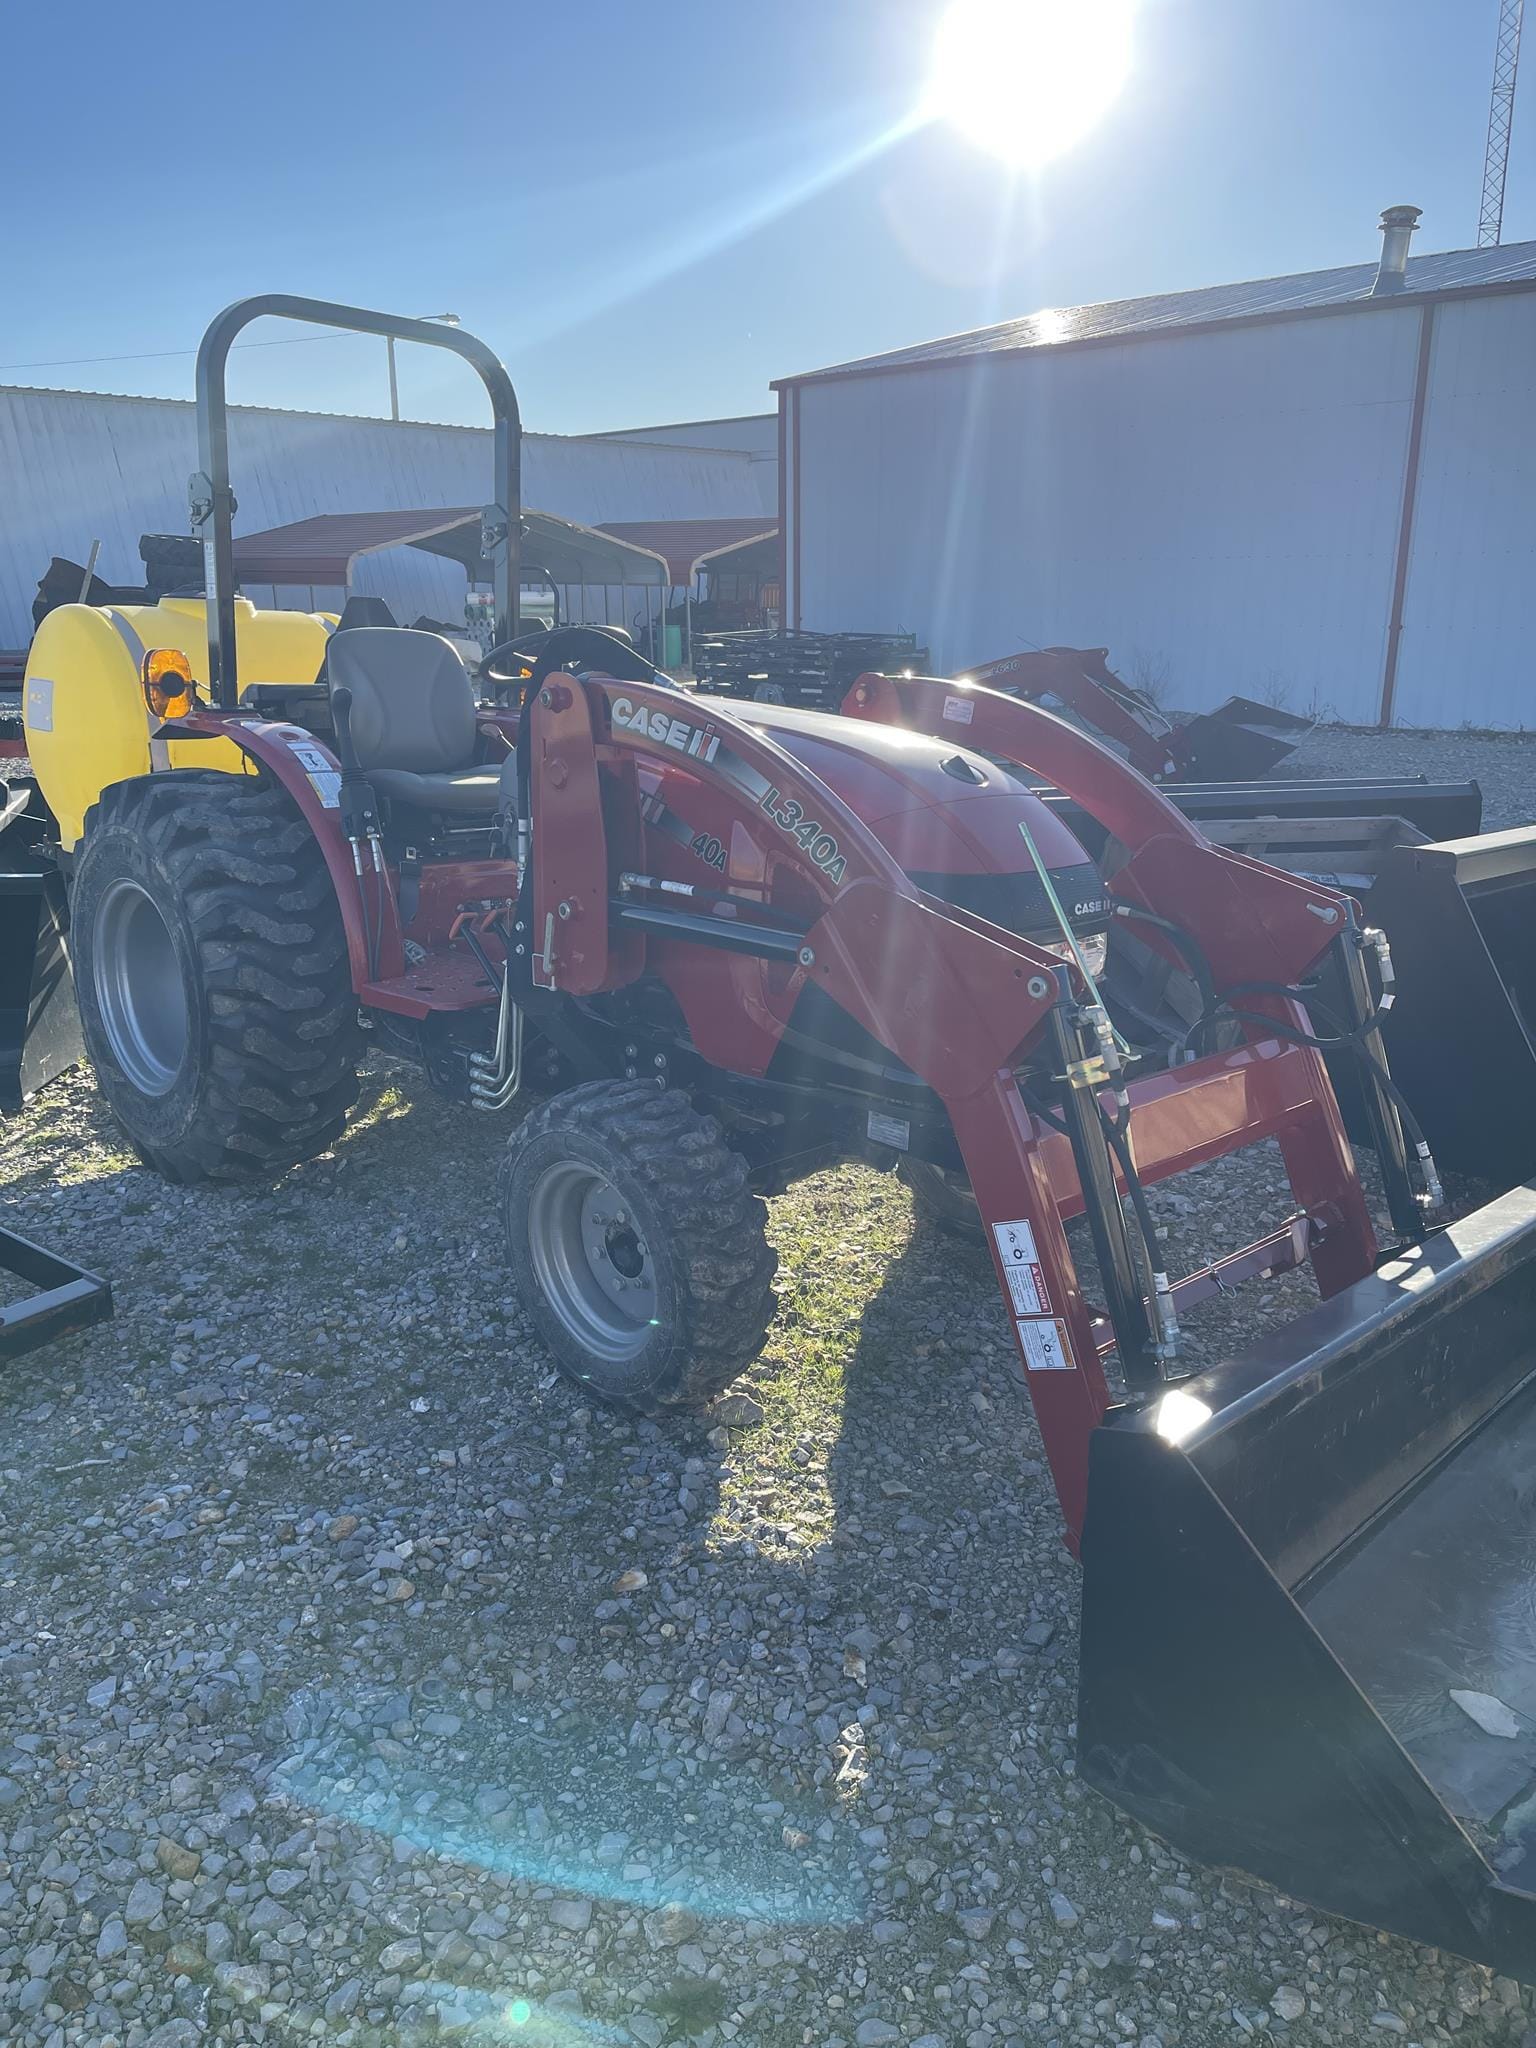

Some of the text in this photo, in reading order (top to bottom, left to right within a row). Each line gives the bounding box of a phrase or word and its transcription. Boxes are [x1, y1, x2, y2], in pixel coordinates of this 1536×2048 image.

[612, 697, 691, 752] CASE
[690, 832, 728, 873] 40A
[760, 788, 847, 885] L340A
[1074, 900, 1102, 915] CASE
[1033, 1275, 1048, 1310] DANGER
